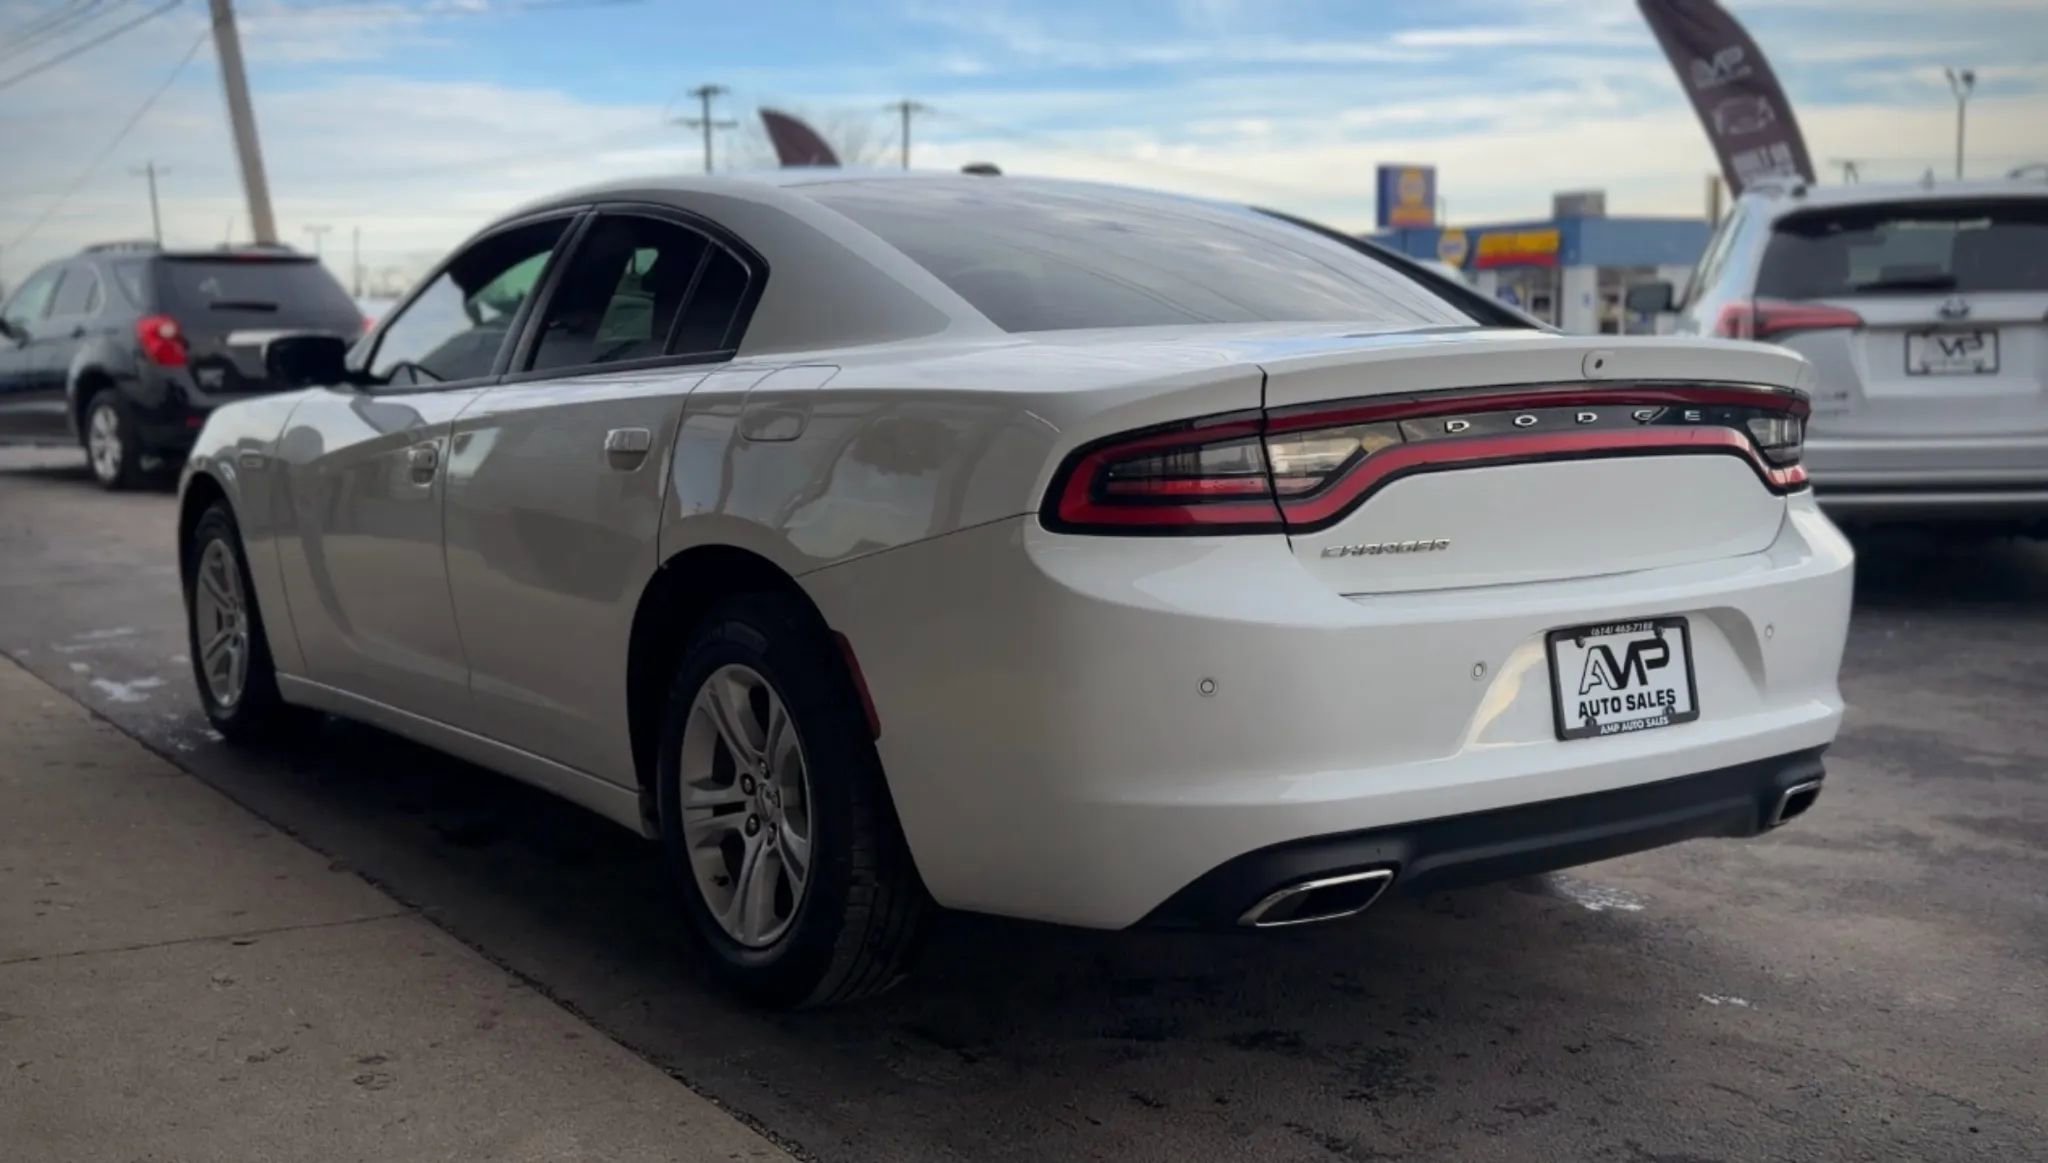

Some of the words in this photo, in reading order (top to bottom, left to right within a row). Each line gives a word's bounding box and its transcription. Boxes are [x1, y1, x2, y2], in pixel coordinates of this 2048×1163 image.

[1444, 408, 1703, 435] DODGE
[1320, 538, 1451, 559] CHARGER
[1578, 696, 1622, 720] AUTO
[1626, 688, 1677, 712] SALES
[1600, 723, 1620, 735] AMP
[1622, 719, 1644, 731] AUTO
[1646, 715, 1669, 728] SALES
